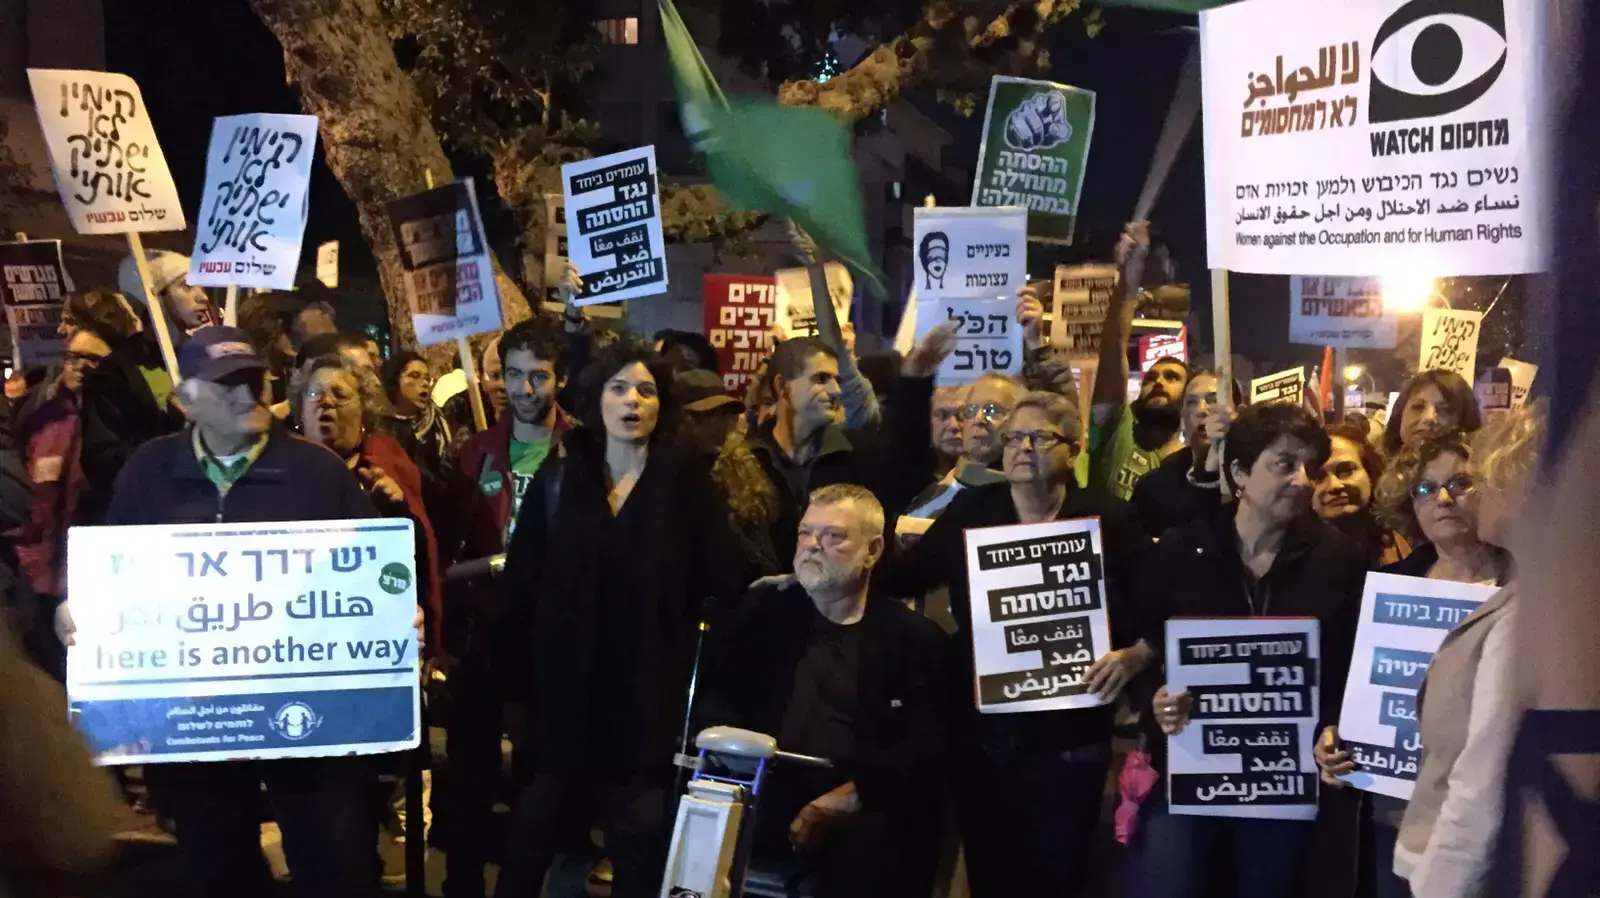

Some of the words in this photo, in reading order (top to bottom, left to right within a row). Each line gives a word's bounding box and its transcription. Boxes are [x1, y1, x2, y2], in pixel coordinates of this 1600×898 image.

[60, 82, 136, 118] הימין
[88, 100, 127, 141] לא
[1241, 99, 1327, 138] למחסומים
[1330, 94, 1358, 128] לא
[223, 126, 303, 163] הימין
[1369, 126, 1434, 158] WATCH
[1440, 118, 1510, 151] מחסום
[67, 134, 148, 177] ישתיק
[234, 144, 284, 188] לא
[998, 150, 1069, 175] ההסתה
[576, 174, 604, 189] ביחד
[606, 163, 645, 182] עומדים
[991, 168, 1067, 195] מתחילה
[1429, 171, 1458, 189] נגד
[1467, 166, 1519, 186] נשים
[74, 170, 152, 205] אותי
[619, 181, 648, 200] נגד
[1235, 184, 1260, 199] אדם
[1265, 180, 1308, 198] זכויות
[1316, 174, 1356, 200] ולמען
[1361, 174, 1423, 193] הכיבוש
[128, 203, 166, 221] שלום
[208, 180, 290, 227] ישתיק
[1436, 199, 1469, 214] ضد
[1474, 193, 1520, 215] نساء
[86, 210, 126, 224] עכשיו
[585, 200, 648, 229] ההסתה
[1273, 205, 1310, 225] حقوق
[1345, 207, 1372, 222] ومن
[201, 218, 270, 253] אותי
[616, 230, 644, 247] نقف
[1235, 232, 1262, 246] Women
[1263, 232, 1296, 249] against
[1299, 230, 1316, 246] the
[1319, 228, 1381, 248] Occupation
[1383, 228, 1405, 244] and
[1408, 227, 1423, 244] for
[1424, 227, 1473, 244] Human
[1477, 223, 1522, 244] Rights
[621, 245, 650, 265] ضد
[966, 244, 1011, 259] בעיניים
[199, 261, 231, 275] עכשיו
[235, 256, 276, 275] שלום
[589, 261, 656, 293] التحريض
[965, 272, 1009, 288] עצומות
[728, 283, 775, 304] ודים
[720, 306, 775, 327] רבים
[1432, 316, 1476, 338] הימין
[709, 328, 774, 349] רבים
[1281, 384, 1298, 396] נגד
[986, 546, 1026, 564] ביחד
[1029, 538, 1086, 558] עומדים
[241, 548, 315, 582] דרך
[330, 545, 377, 573] יש
[1049, 561, 1091, 584] נגד
[285, 589, 374, 620] هناك
[1000, 586, 1092, 615] ההסתה
[1384, 602, 1431, 620] ביחד
[175, 592, 274, 633] طريق
[1043, 624, 1084, 642] نقف
[97, 644, 168, 670] here
[178, 641, 201, 667] is
[211, 635, 338, 666] another
[346, 637, 410, 667] way
[1049, 643, 1091, 666] ضد
[1186, 643, 1233, 659] ביחד
[1236, 640, 1303, 657] עומדים
[1256, 666, 1304, 686] נגד
[1200, 691, 1303, 713] ההסתה
[1244, 730, 1290, 746] نقف
[1250, 750, 1297, 772] ضد
[1196, 774, 1305, 803] التحريض
